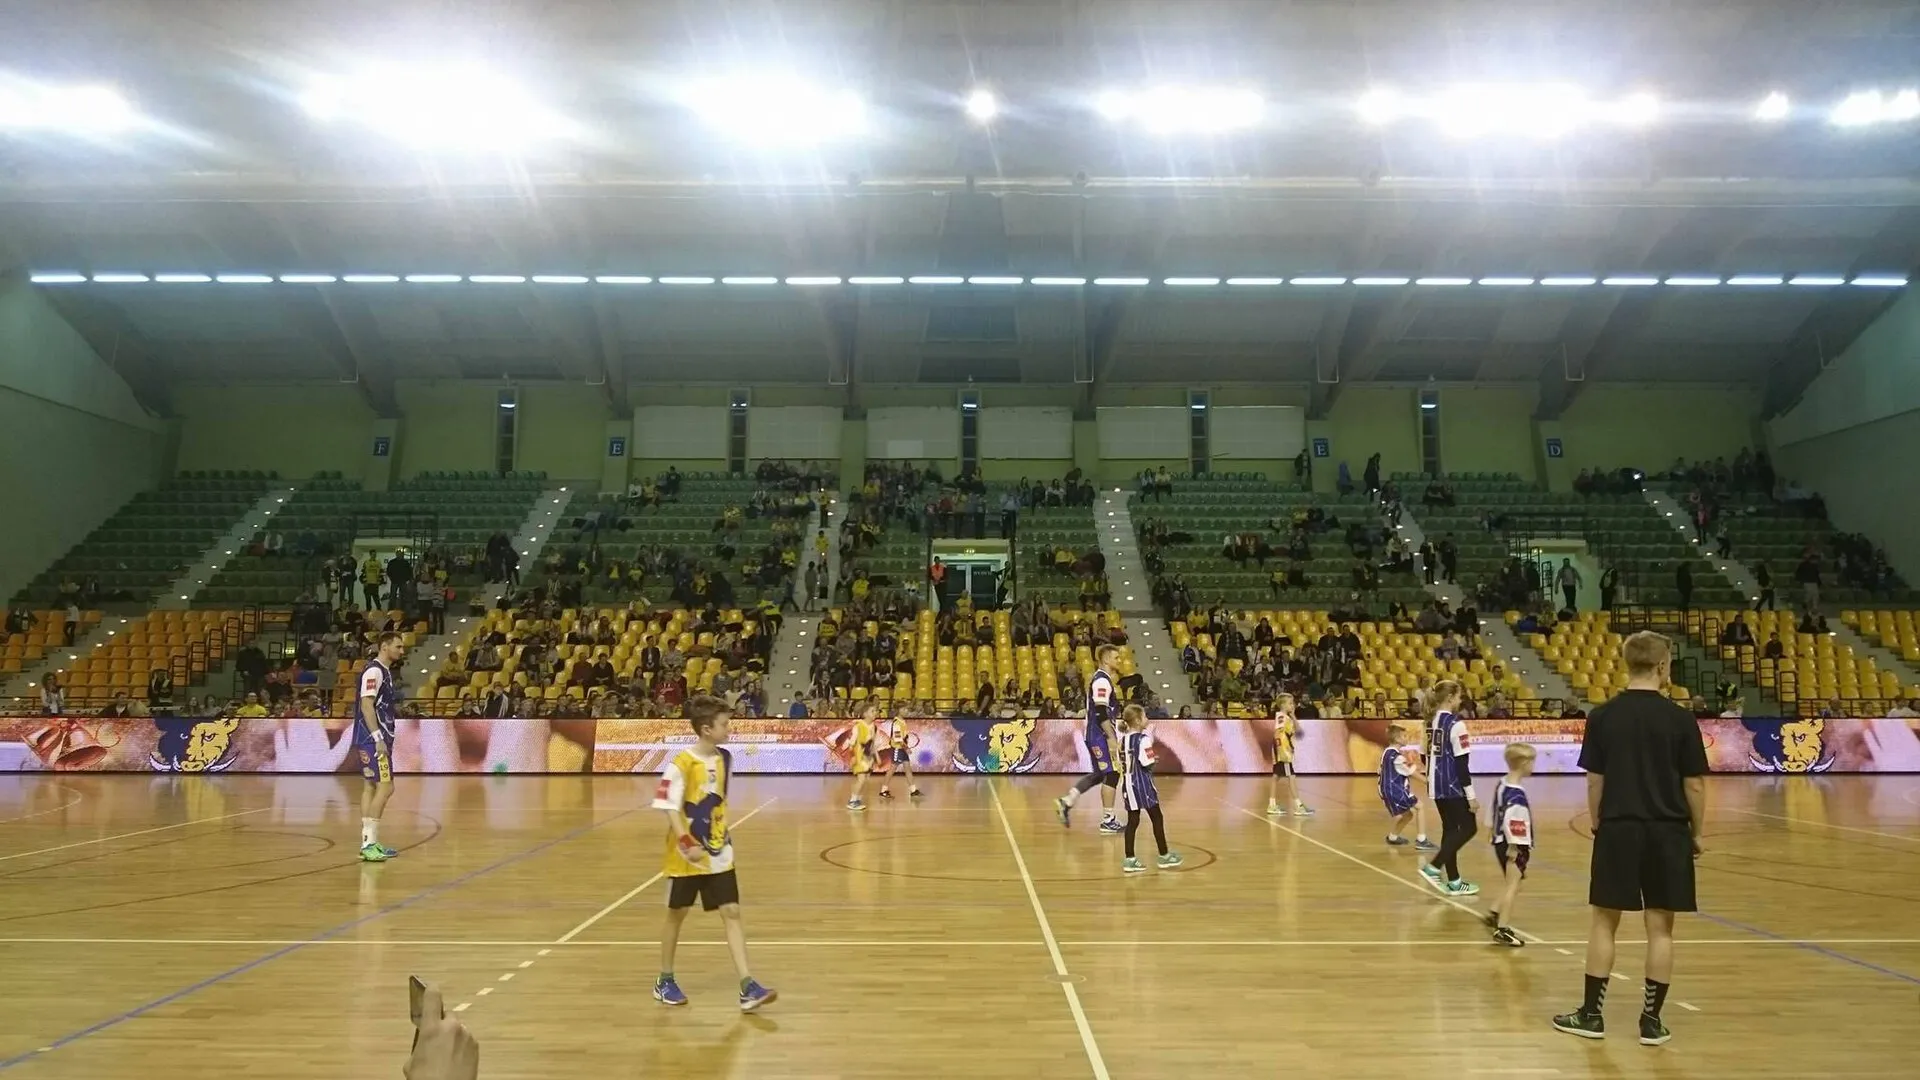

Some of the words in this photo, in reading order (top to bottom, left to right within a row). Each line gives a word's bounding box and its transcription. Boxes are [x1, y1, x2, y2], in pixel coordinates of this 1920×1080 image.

[377, 443, 387, 454] F
[612, 443, 622, 454] E
[1317, 444, 1327, 456] E
[1550, 445, 1561, 456] D
